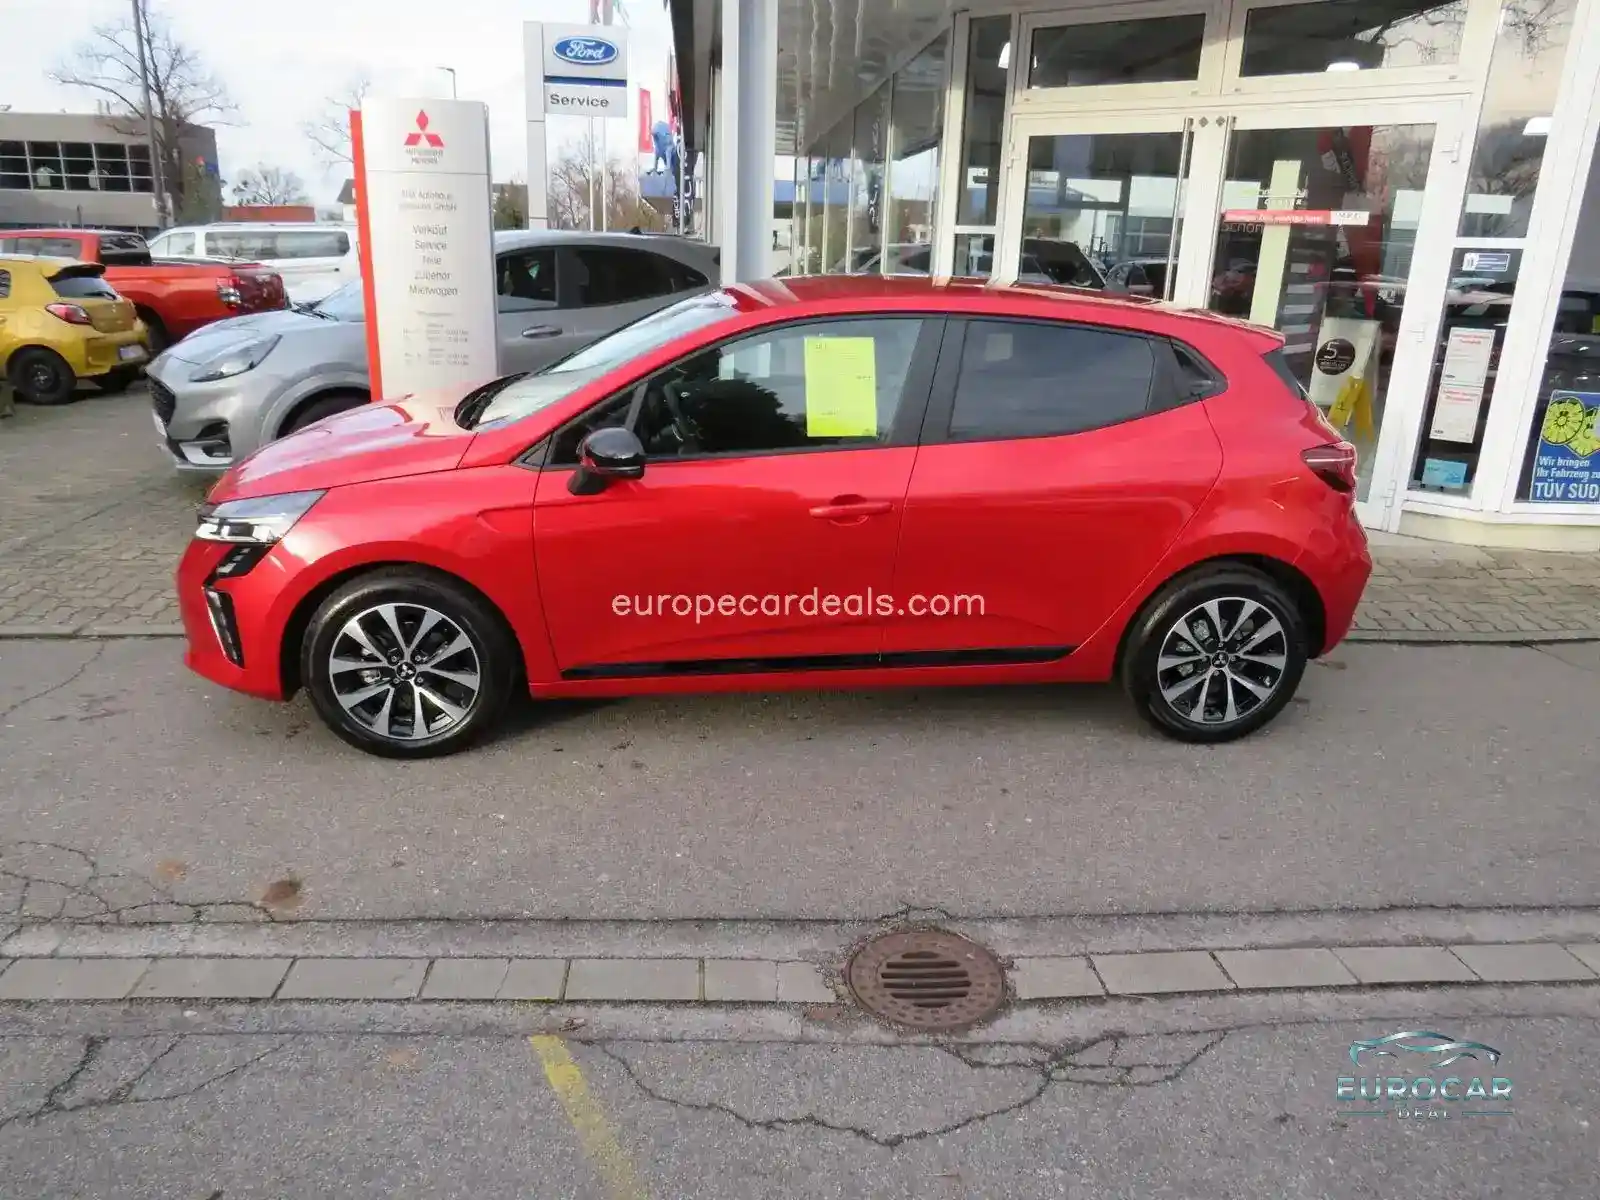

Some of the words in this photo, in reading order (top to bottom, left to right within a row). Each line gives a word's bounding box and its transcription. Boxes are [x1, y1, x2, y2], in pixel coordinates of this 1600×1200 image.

[566, 40, 605, 60] Ford
[549, 93, 609, 107] Service
[412, 225, 447, 236] Verkauf
[414, 240, 447, 250] Service
[1323, 341, 1340, 359] 5
[1539, 456, 1555, 466] Wir
[1557, 456, 1590, 469] bringen
[1536, 467, 1549, 477] Ihr
[1551, 467, 1590, 480] Fahrzeug
[1535, 479, 1566, 498] TÜV
[1567, 479, 1599, 499] SÜD
